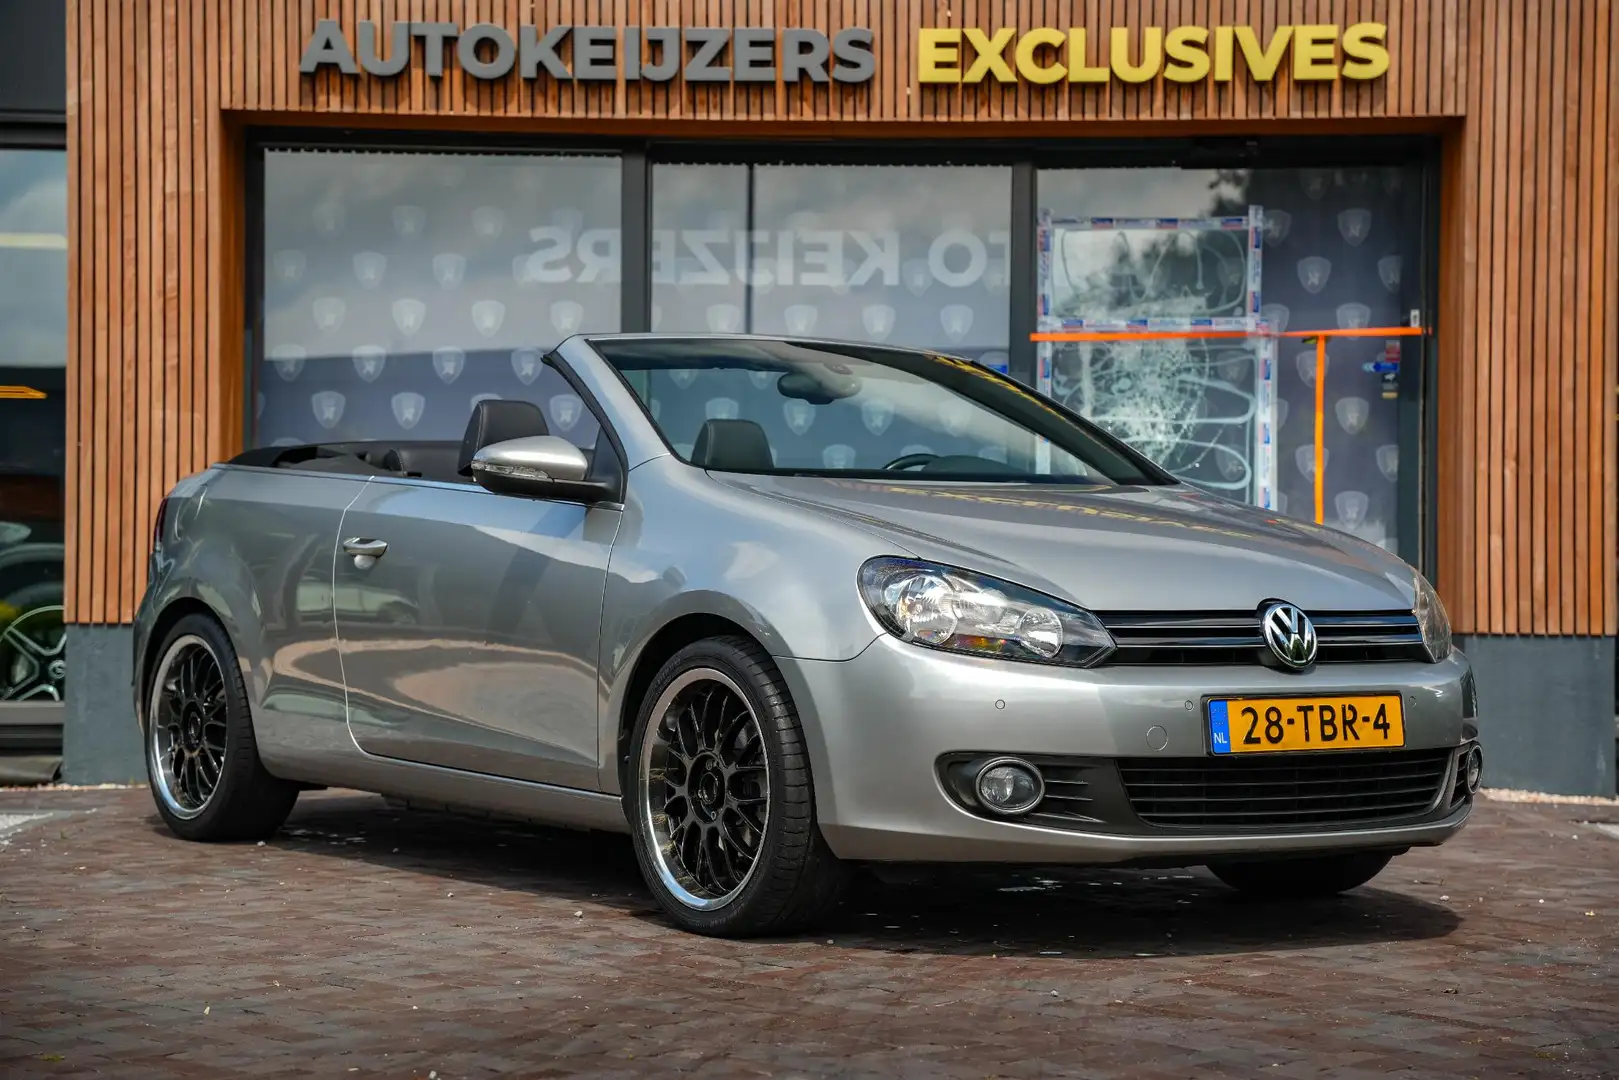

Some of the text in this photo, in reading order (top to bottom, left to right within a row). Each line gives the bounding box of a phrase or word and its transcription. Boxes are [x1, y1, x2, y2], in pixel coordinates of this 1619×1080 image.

[299, 19, 1390, 84] AUTOKEIJZERS EXCLUSIVES
[1213, 703, 1391, 745] NL 28-TBR-4
